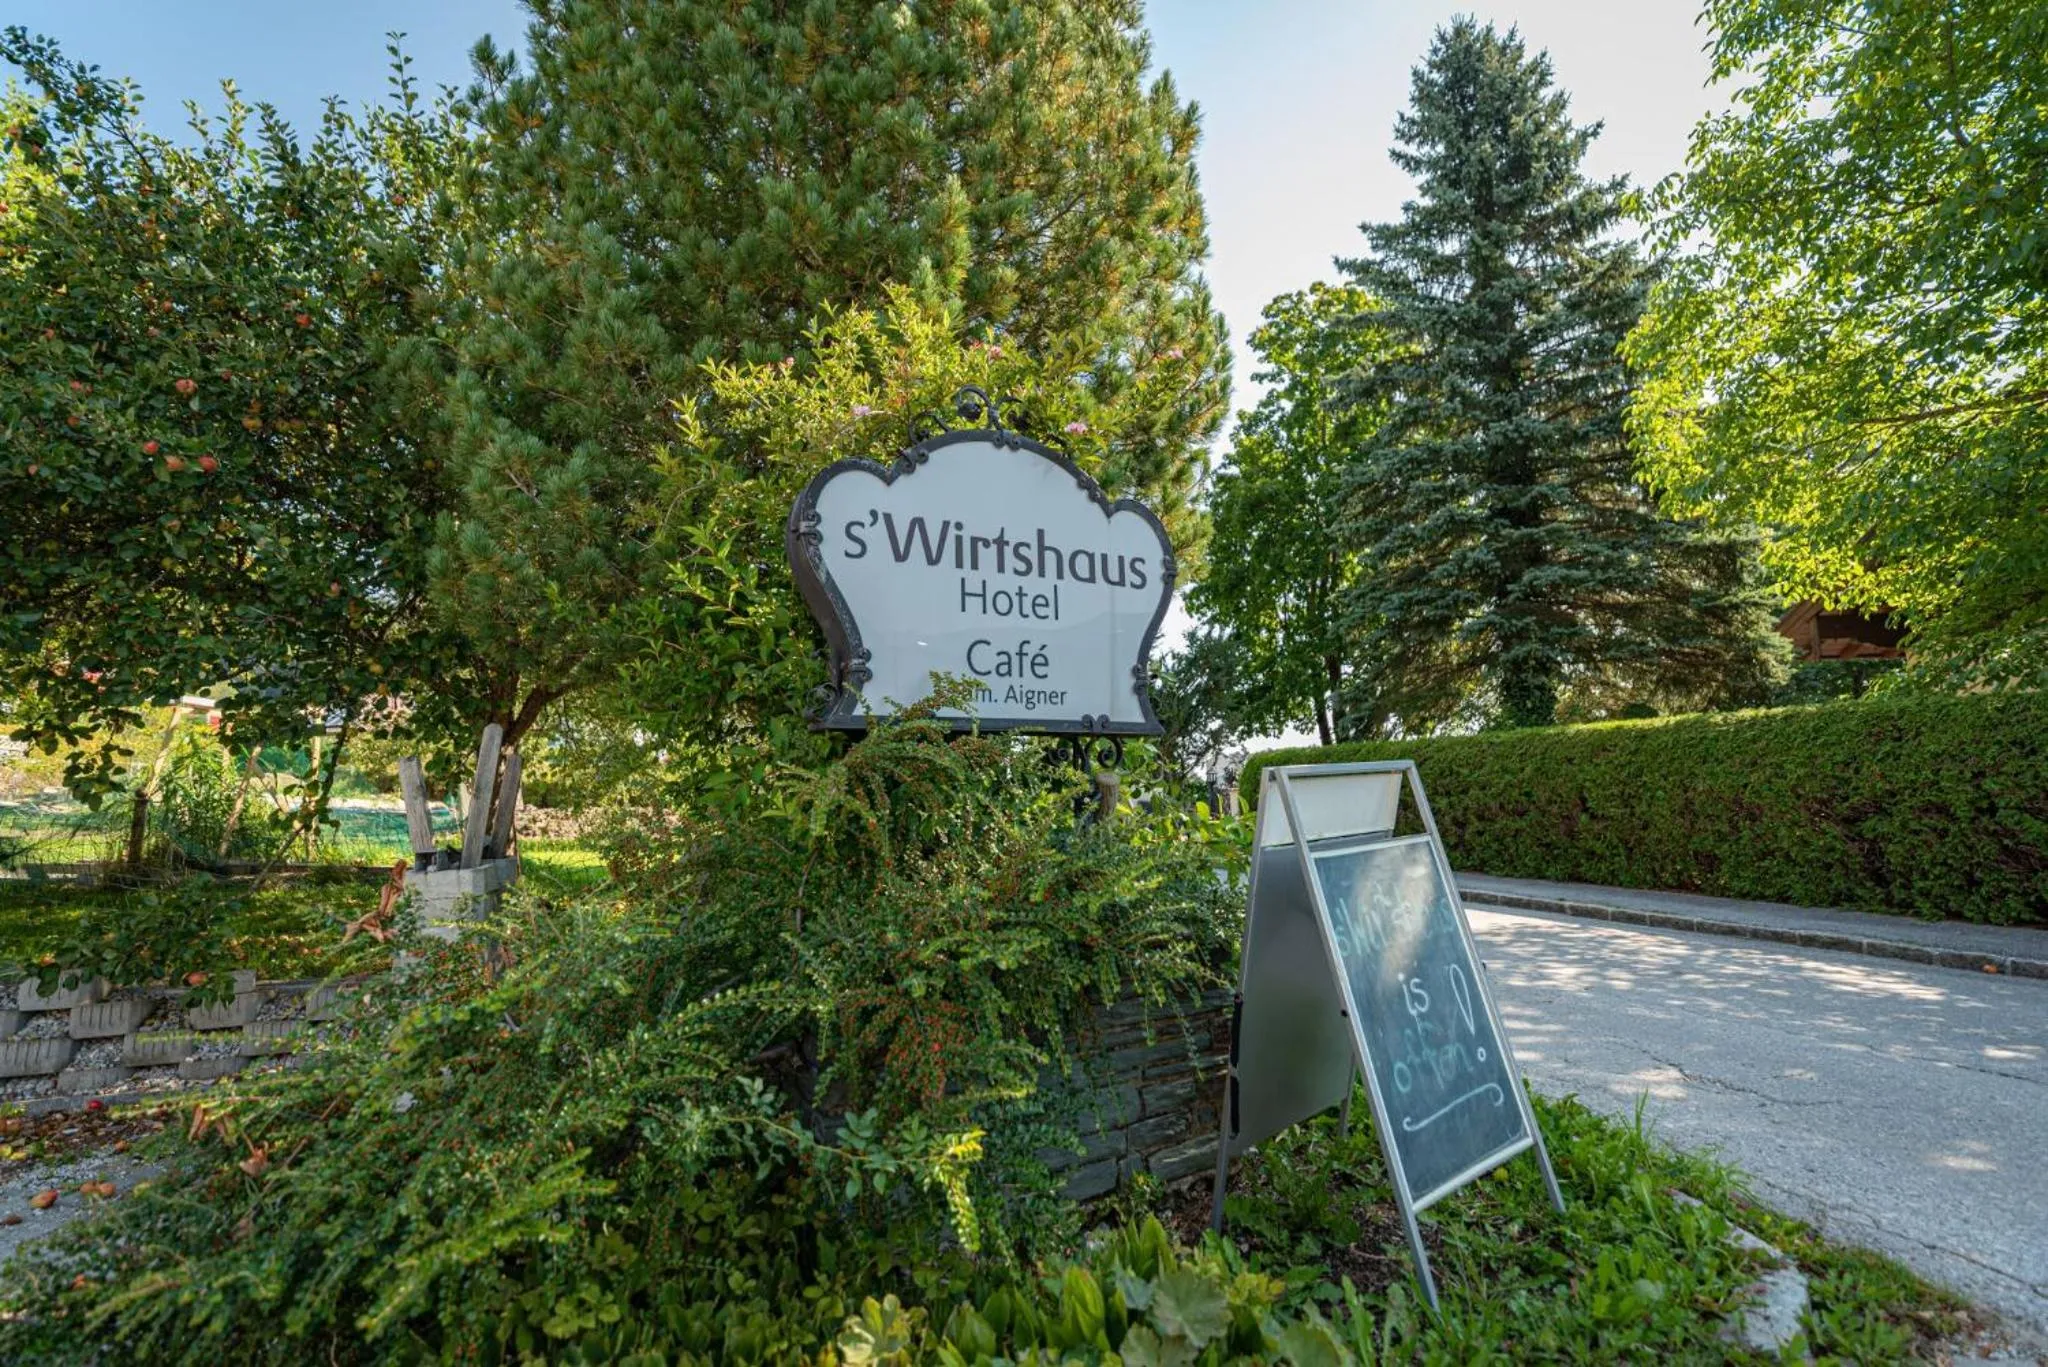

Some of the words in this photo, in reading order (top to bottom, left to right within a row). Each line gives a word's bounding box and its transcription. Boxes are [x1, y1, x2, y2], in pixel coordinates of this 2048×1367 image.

[843, 508, 1148, 590] s'Wirtshaus
[960, 576, 1060, 621] Hotel
[965, 639, 1050, 680] Café
[967, 686, 998, 704] m.
[1003, 683, 1068, 710] Aigner
[1397, 971, 1430, 1017] is
